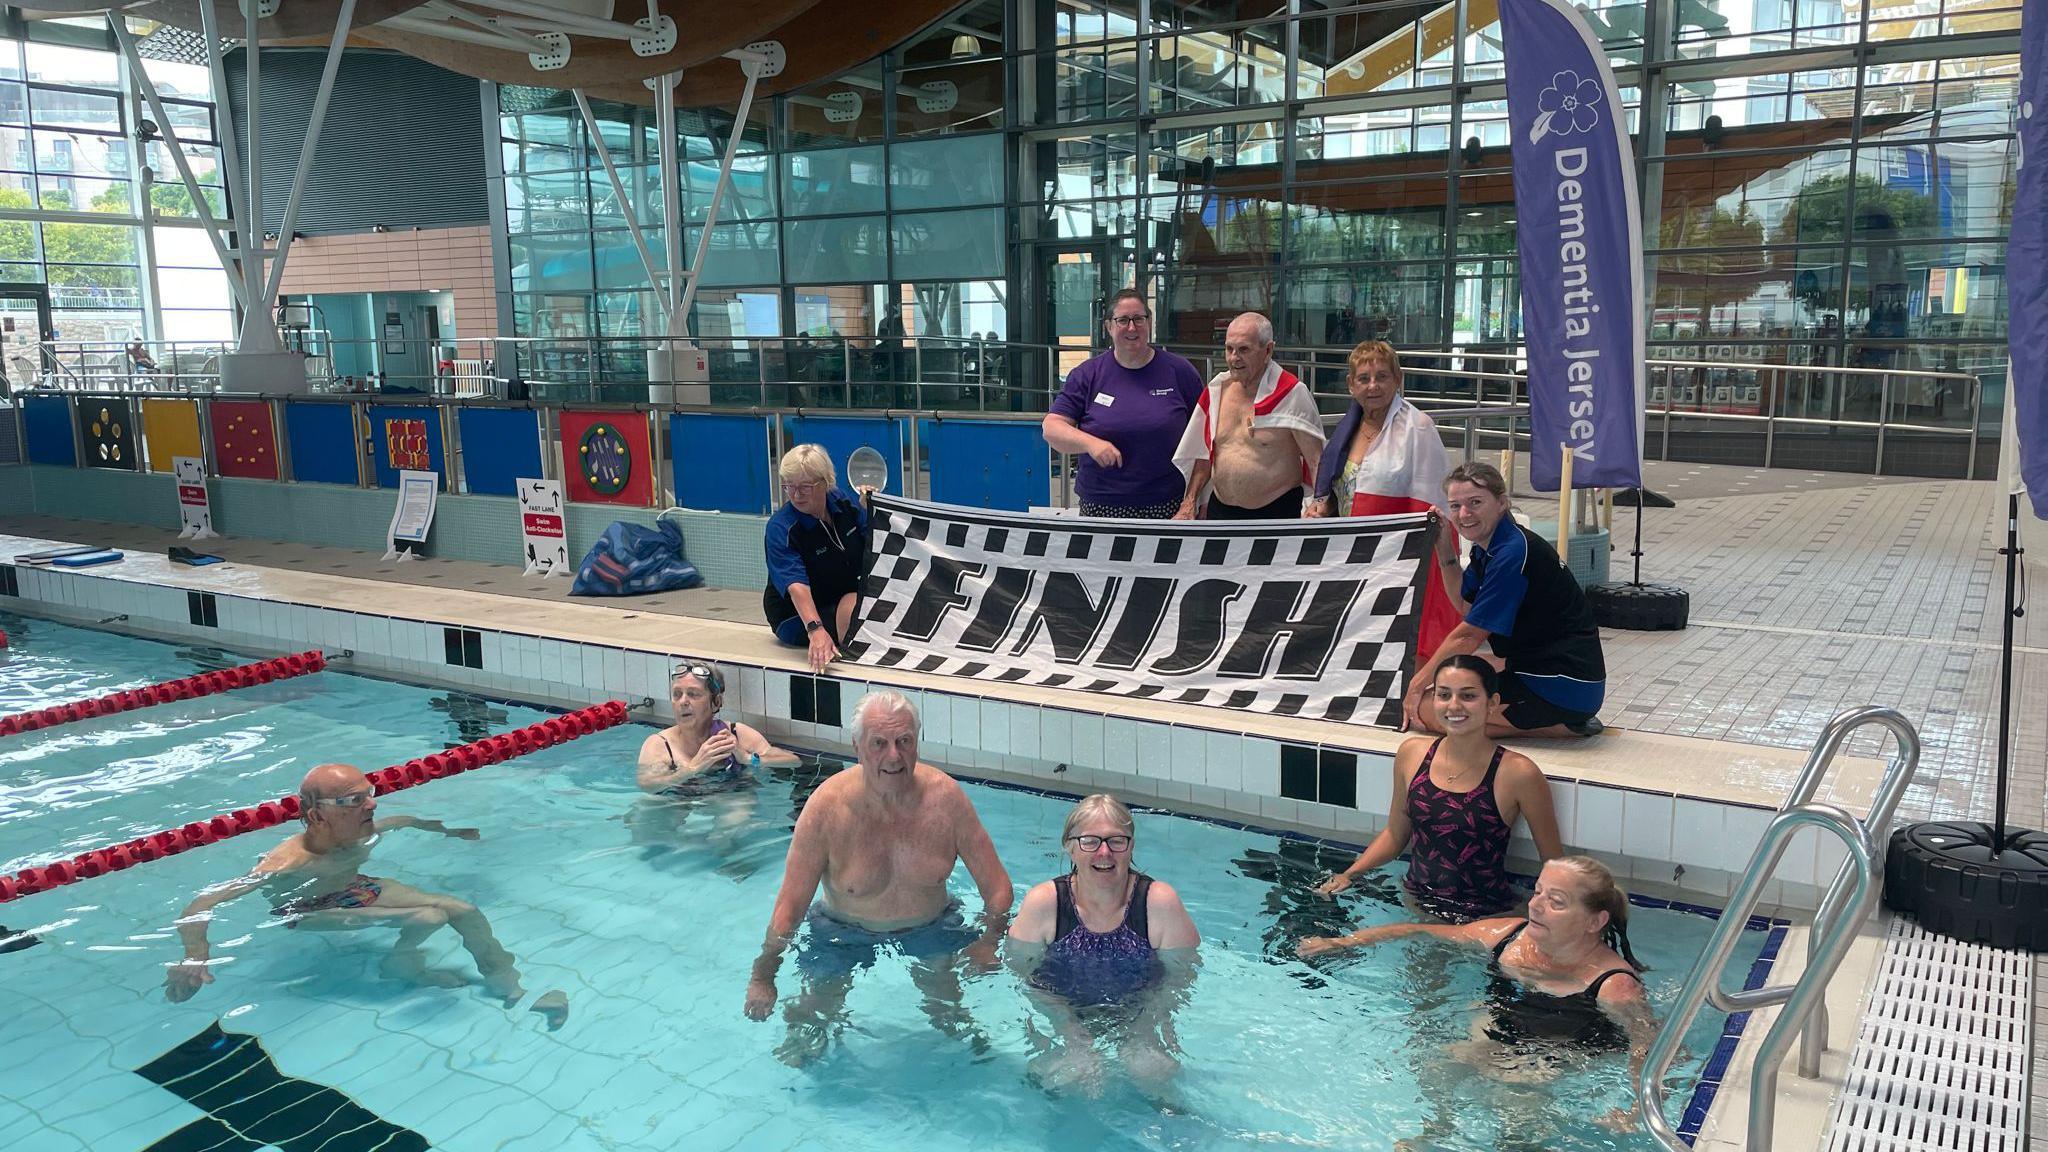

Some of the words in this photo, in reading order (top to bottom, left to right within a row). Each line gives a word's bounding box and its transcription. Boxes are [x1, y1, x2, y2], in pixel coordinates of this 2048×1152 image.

[1555, 147, 1600, 339] Dementia
[1560, 349, 1600, 462] Jersey
[535, 517, 551, 525] Swim
[892, 556, 1368, 681] FINISH
